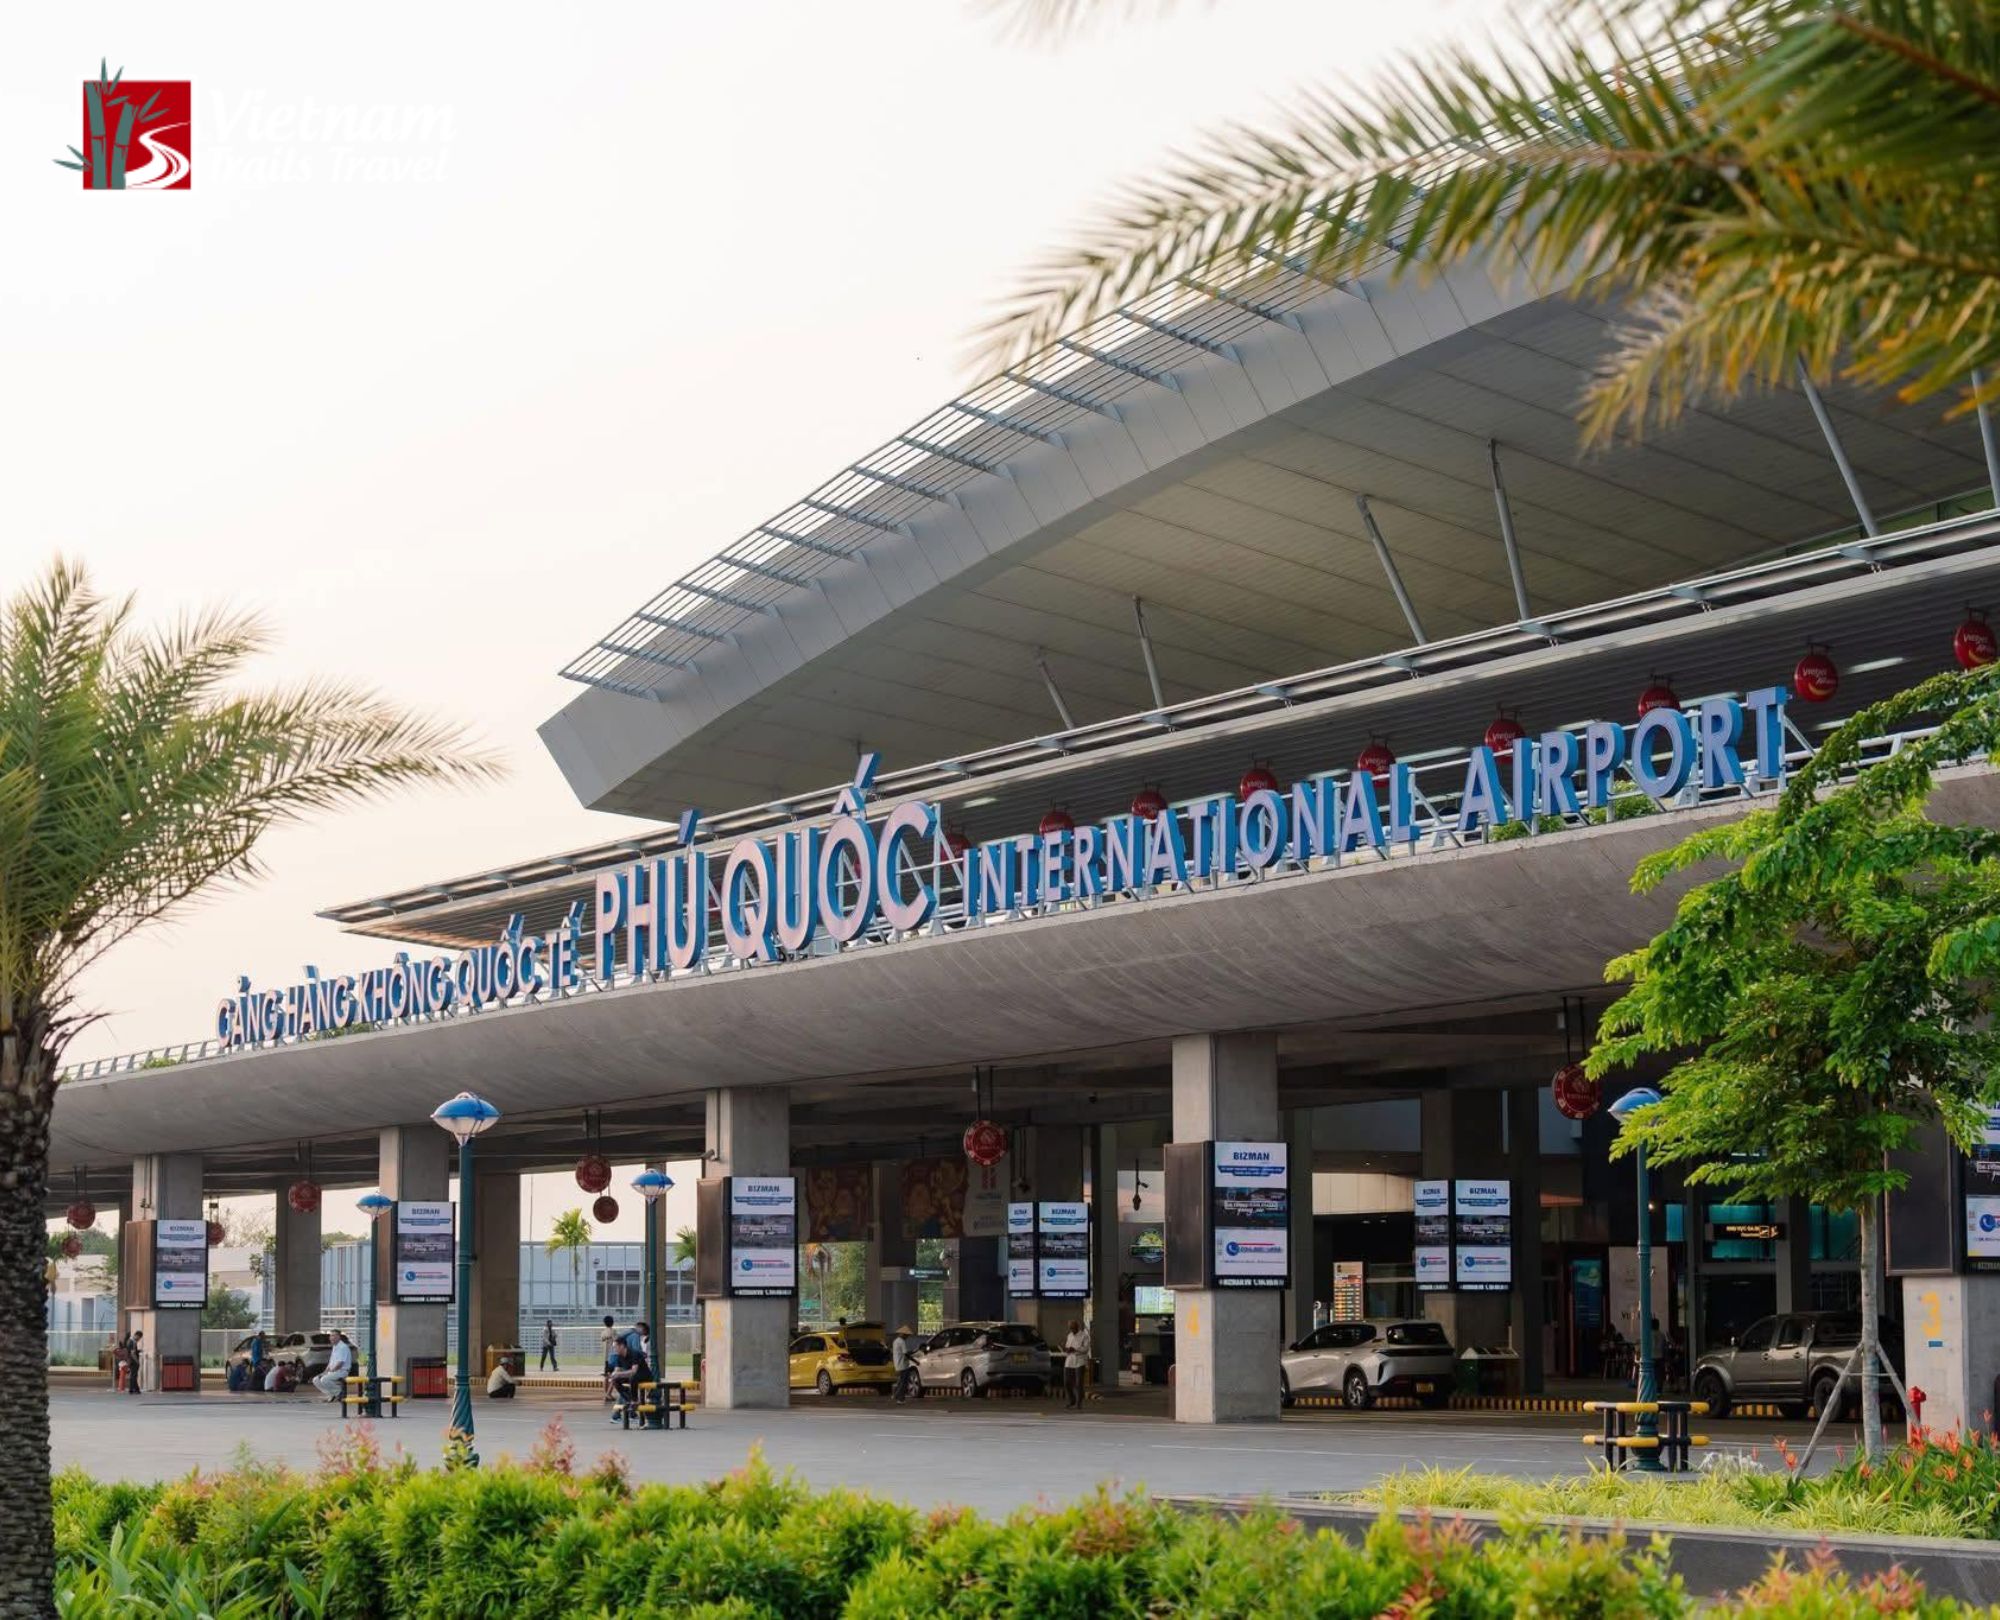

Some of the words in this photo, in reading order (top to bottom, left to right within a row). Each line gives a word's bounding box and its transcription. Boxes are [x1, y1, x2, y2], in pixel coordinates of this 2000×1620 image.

[963, 763, 1420, 917] INTERNATIONAL
[1458, 685, 1788, 832] AIRPORT
[595, 808, 708, 981] PHÚ
[721, 751, 938, 962] QUỐC
[215, 974, 284, 1048] CẢNG
[286, 964, 357, 1037] HÀNG
[359, 951, 454, 1024] KHÔNG
[456, 911, 546, 1008] QUỐC
[545, 899, 587, 989] TẾ
[747, 1185, 780, 1193] BIZMAN
[1233, 1151, 1270, 1161] BIZMAN
[1469, 1187, 1498, 1195] BIZMAN
